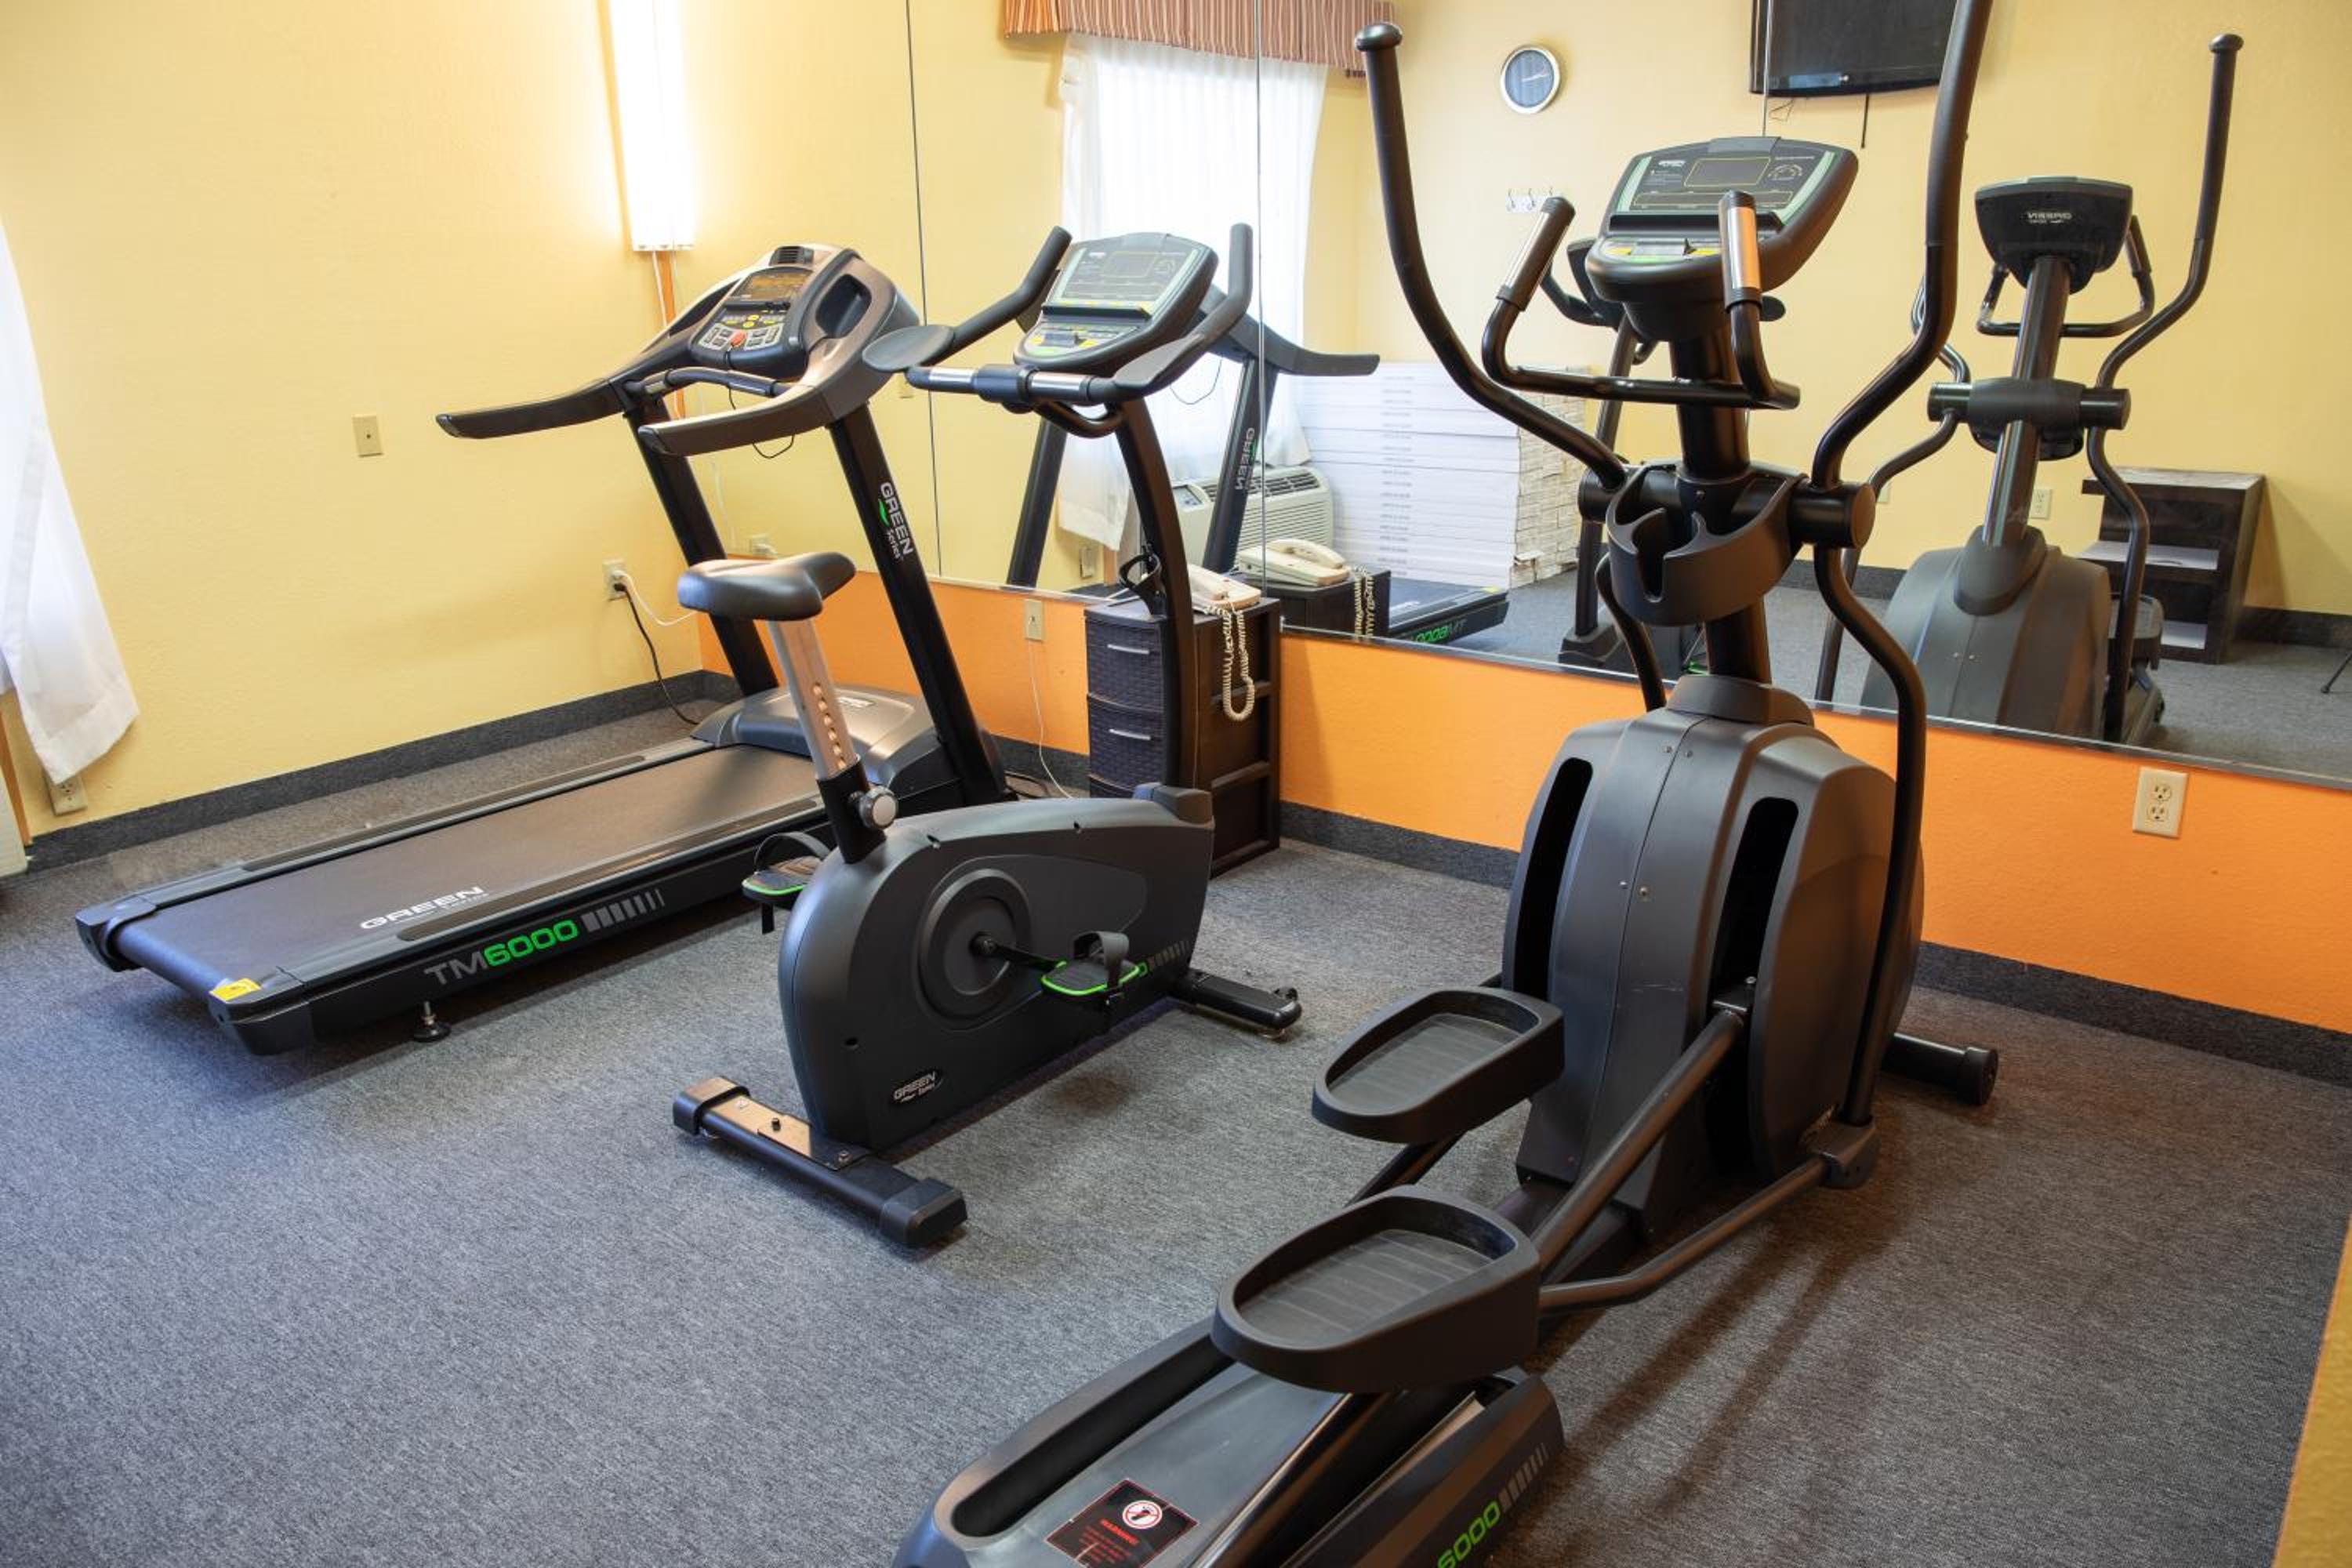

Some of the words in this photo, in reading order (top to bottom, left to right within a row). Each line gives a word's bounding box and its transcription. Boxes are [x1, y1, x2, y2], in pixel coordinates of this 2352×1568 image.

[880, 482, 913, 555] GREEN
[360, 886, 485, 929] GREEN
[424, 919, 579, 985] TM6000
